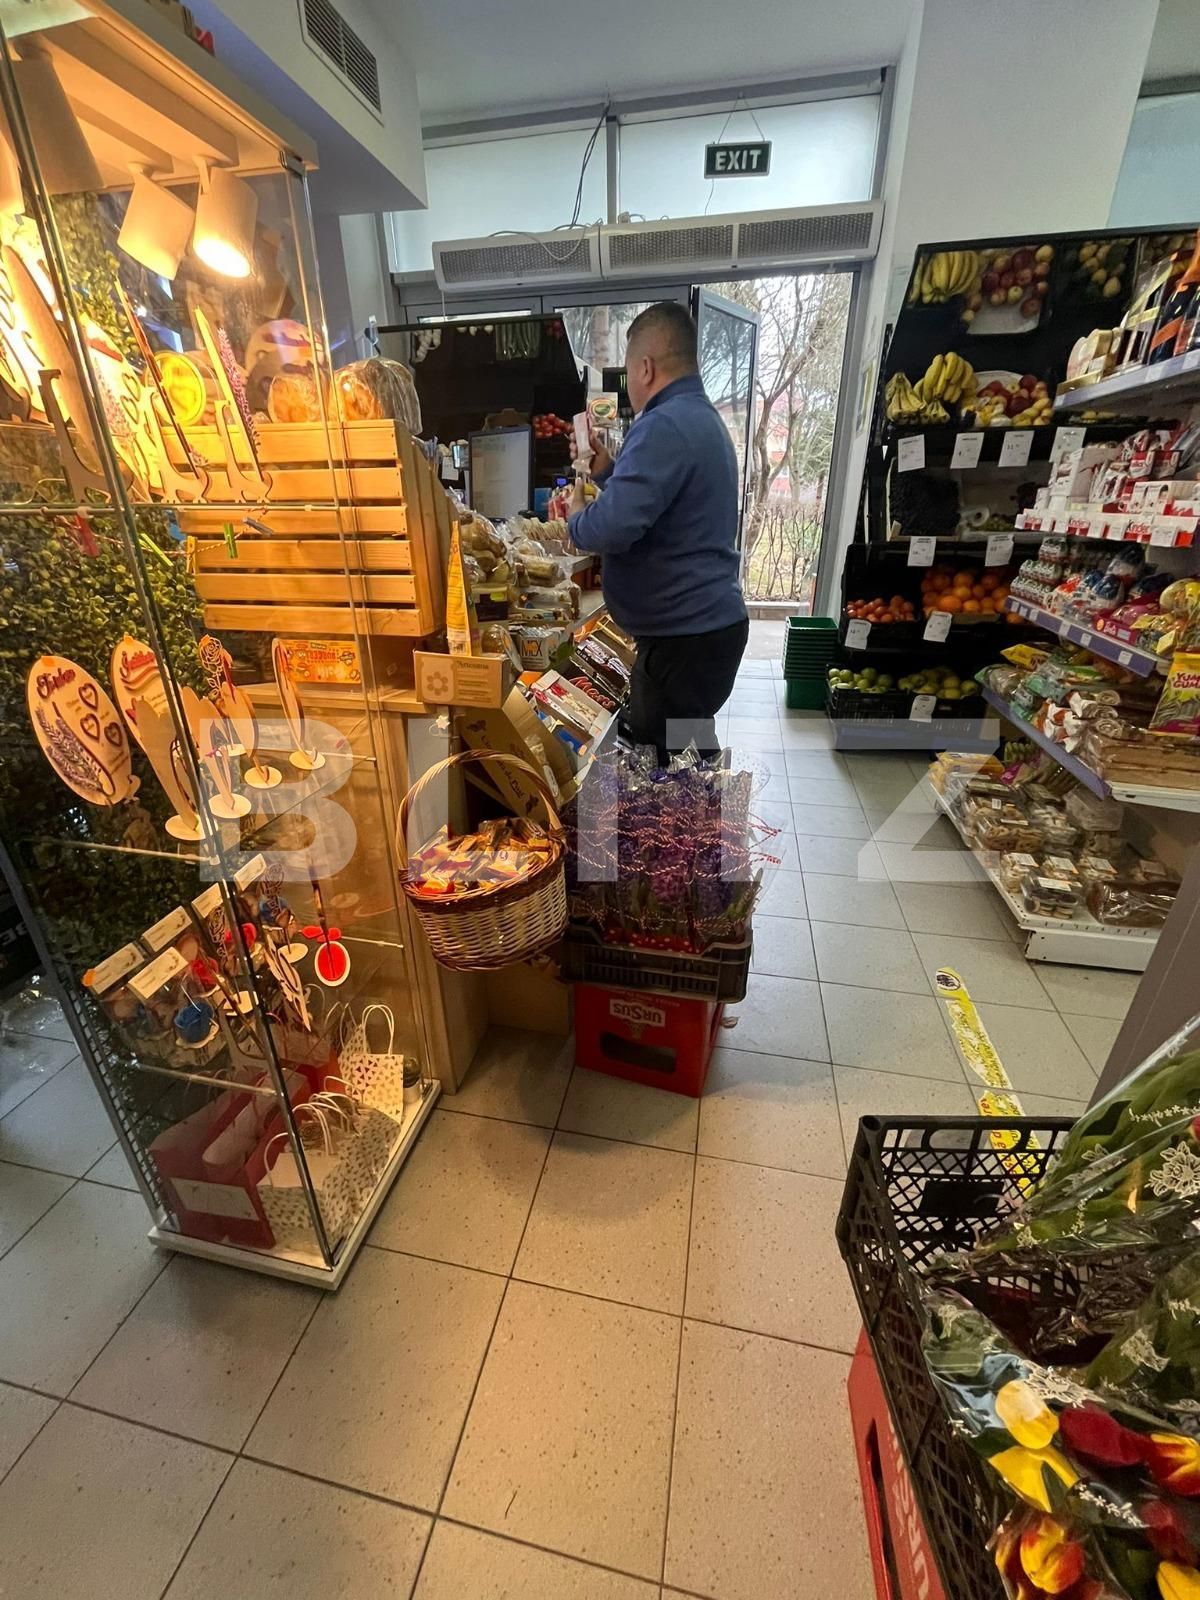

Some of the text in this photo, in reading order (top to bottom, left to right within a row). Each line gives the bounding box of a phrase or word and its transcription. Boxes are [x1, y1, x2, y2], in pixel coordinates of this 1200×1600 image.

[715, 150, 762, 170] EXIT
[568, 676, 617, 709] Mars
[613, 1002, 663, 1024] URSUS
